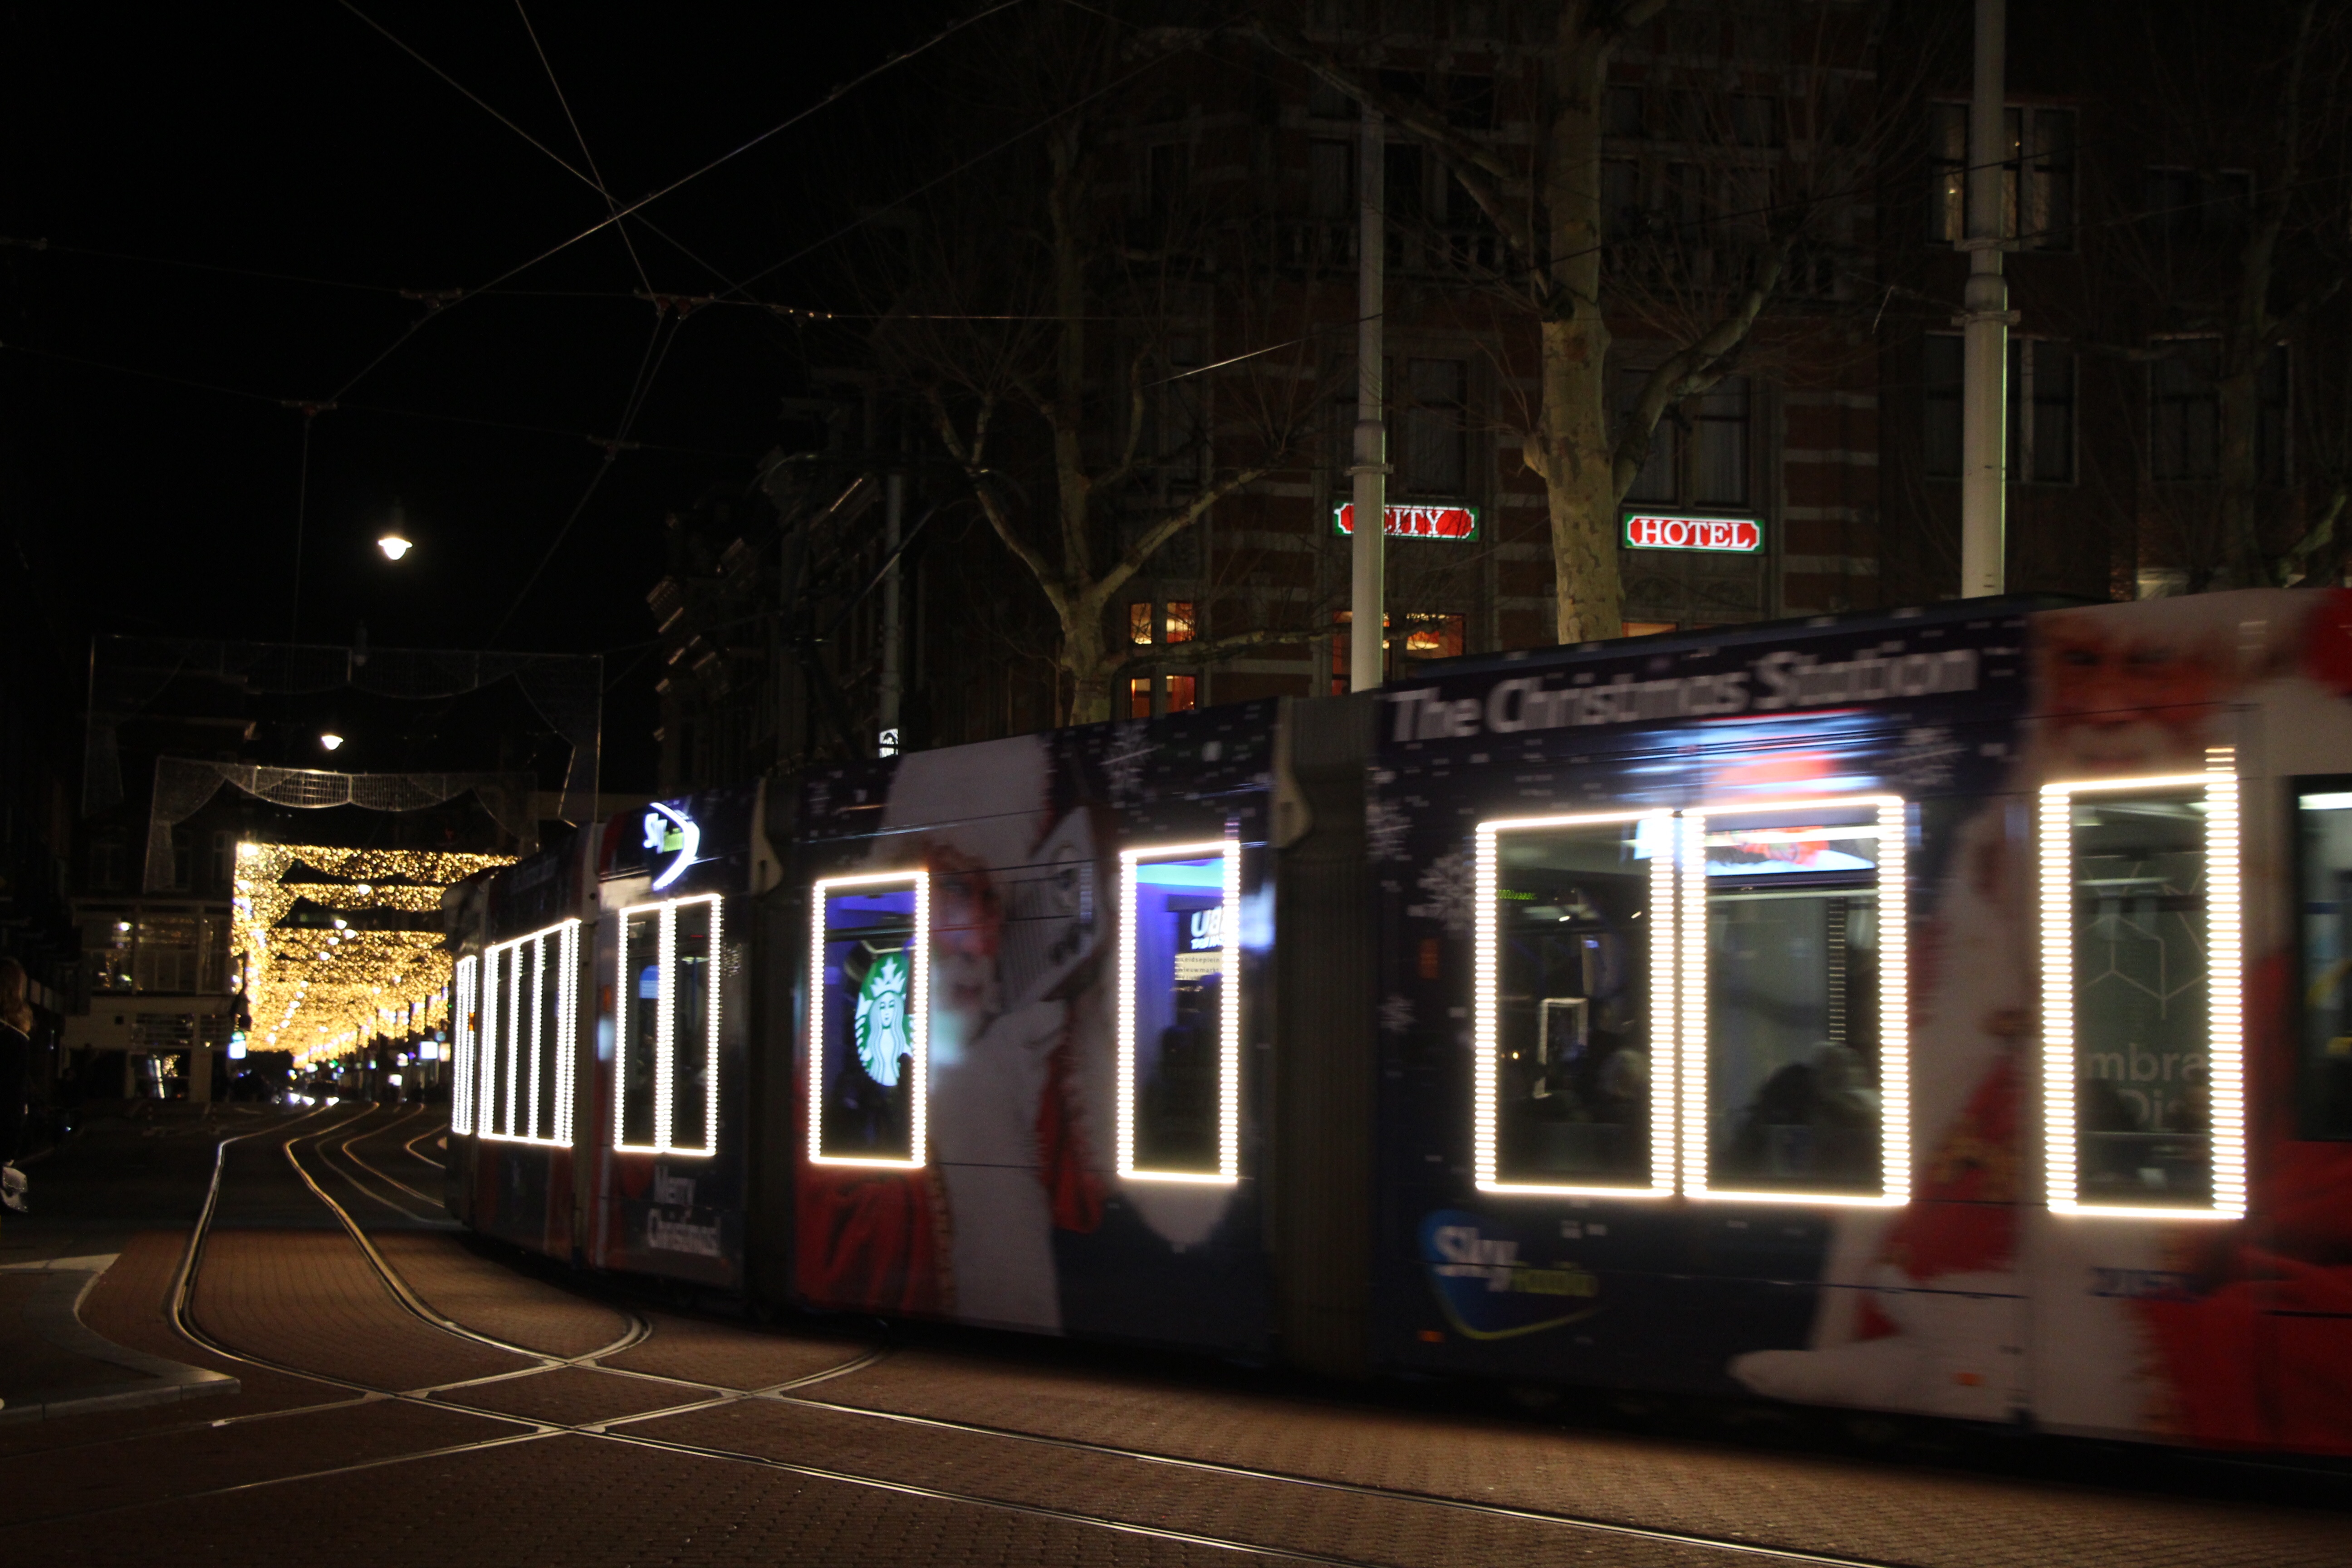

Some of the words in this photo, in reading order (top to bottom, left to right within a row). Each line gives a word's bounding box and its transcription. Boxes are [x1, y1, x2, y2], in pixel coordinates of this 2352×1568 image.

[1640, 519, 1750, 547] HOTEL
[1389, 686, 1480, 742] The
[1486, 671, 1750, 733] Christmas
